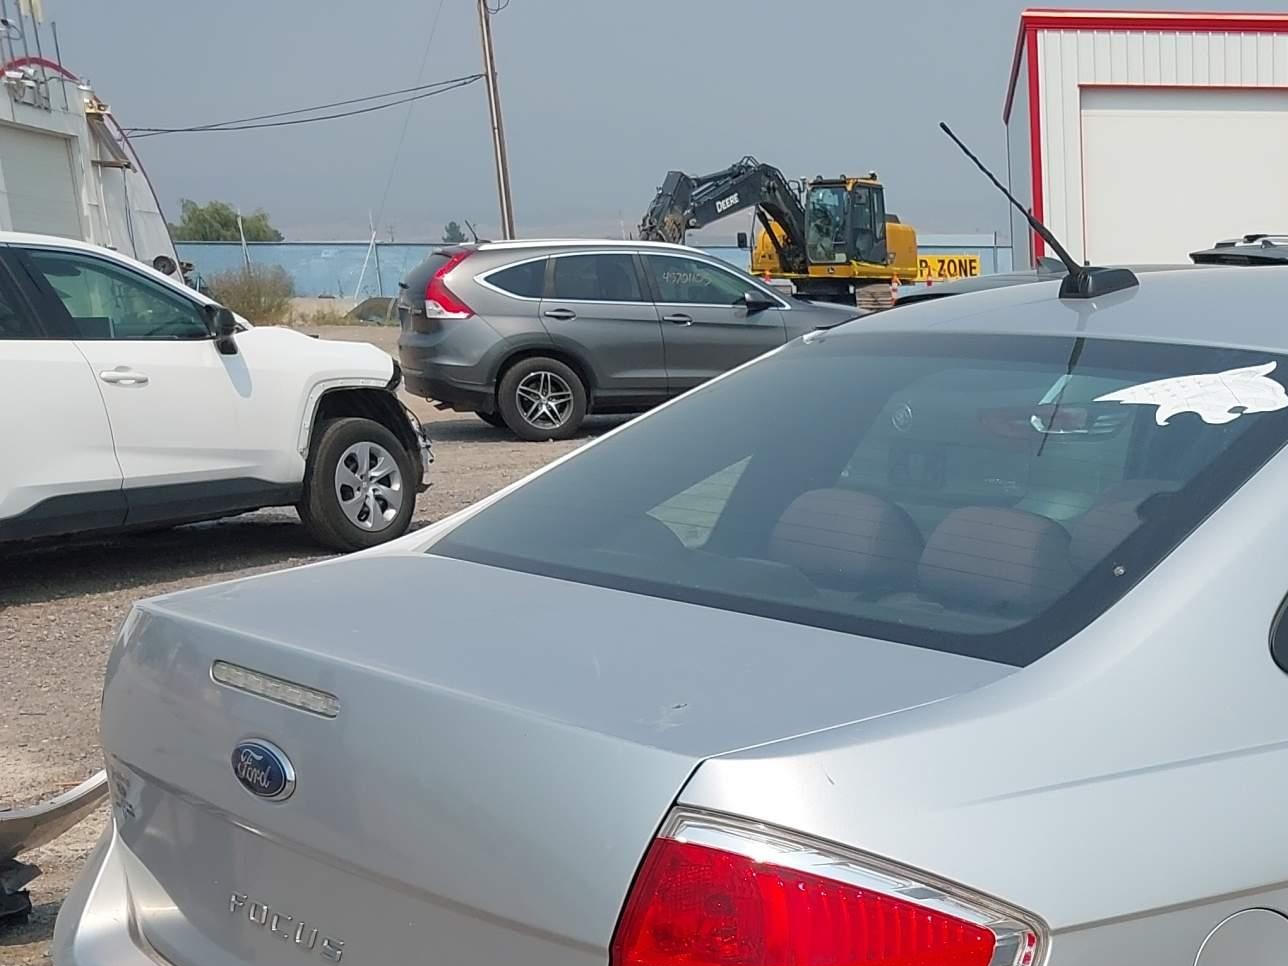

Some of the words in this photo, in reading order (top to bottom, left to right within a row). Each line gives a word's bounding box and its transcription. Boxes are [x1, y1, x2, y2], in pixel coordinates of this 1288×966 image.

[716, 192, 739, 213] DEERE
[937, 258, 977, 278] ZONE
[237, 748, 271, 788] Ford
[229, 891, 344, 963] FOCUS
